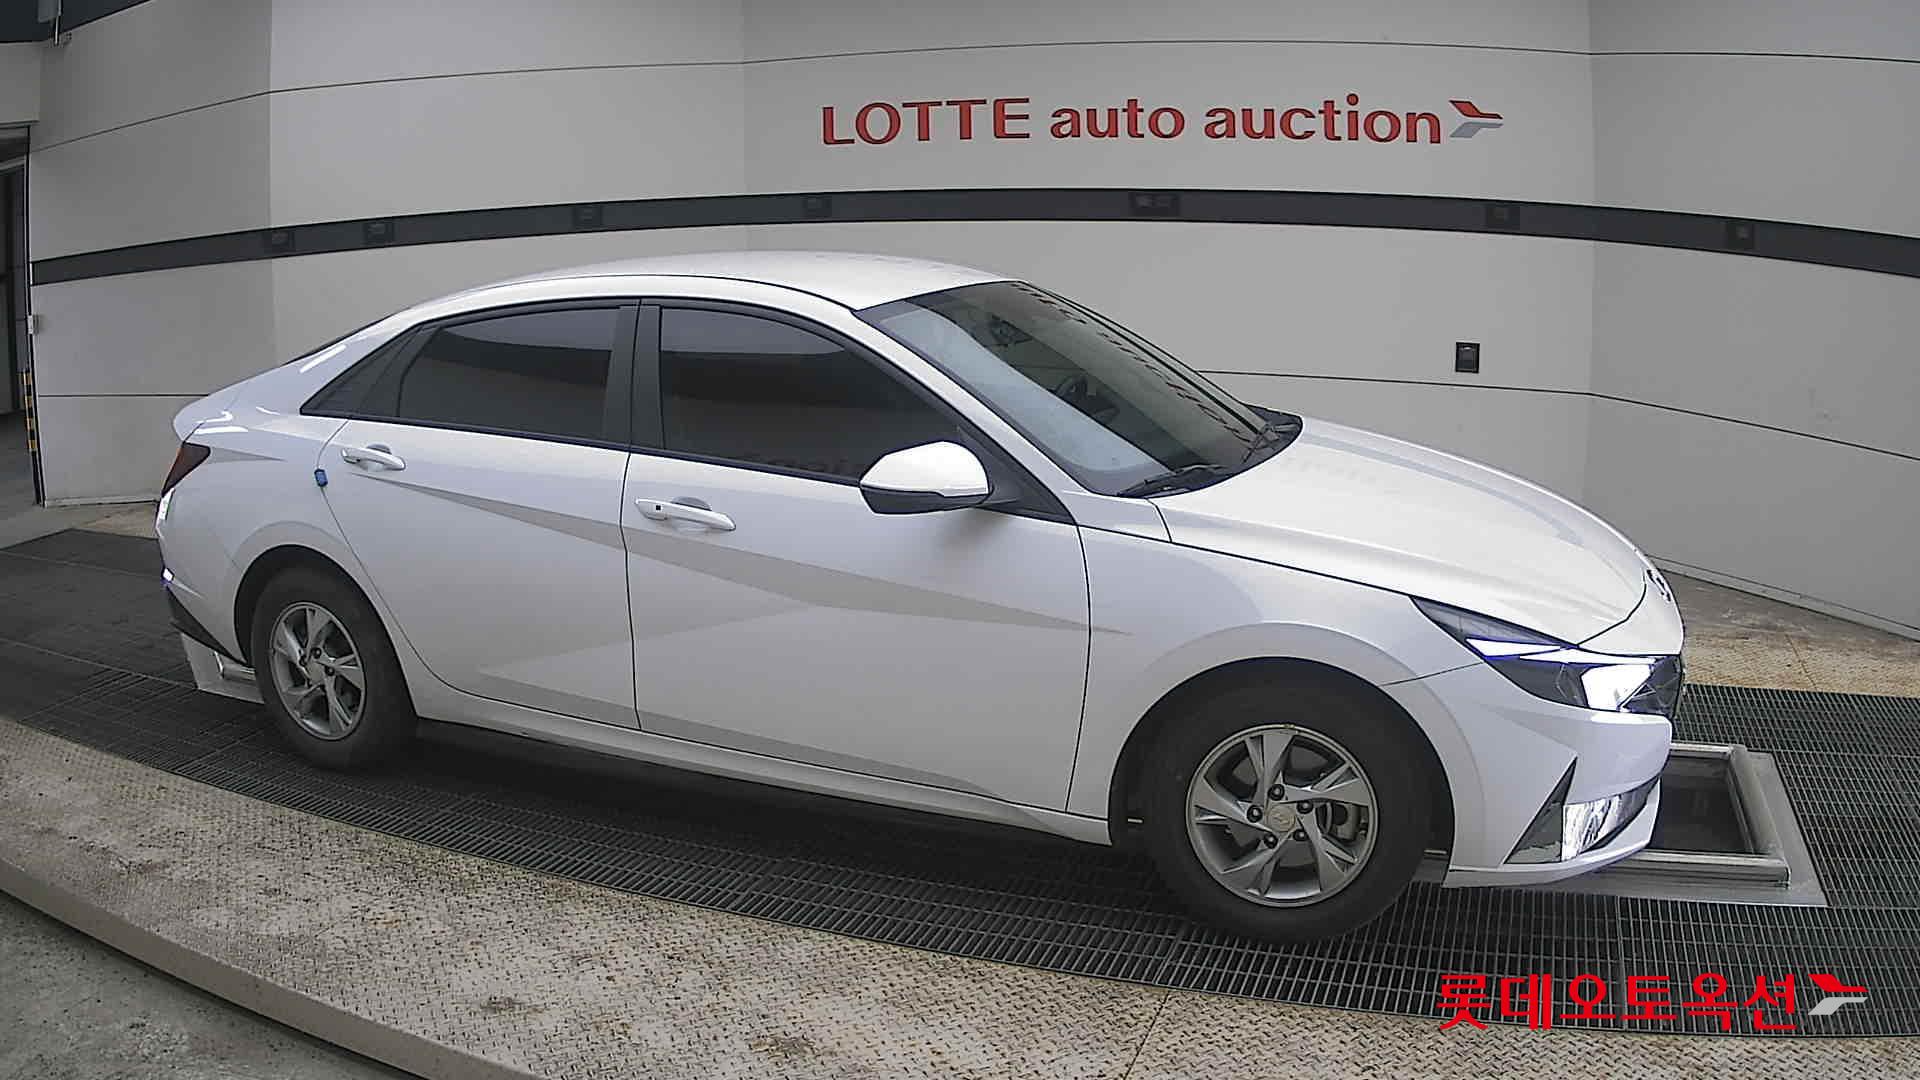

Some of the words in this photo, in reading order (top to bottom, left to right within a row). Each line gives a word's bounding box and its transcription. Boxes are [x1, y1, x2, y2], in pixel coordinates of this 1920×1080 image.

[822, 98, 1030, 144] LOTTE
[1050, 98, 1185, 138] auto
[1203, 93, 1442, 144] auction
